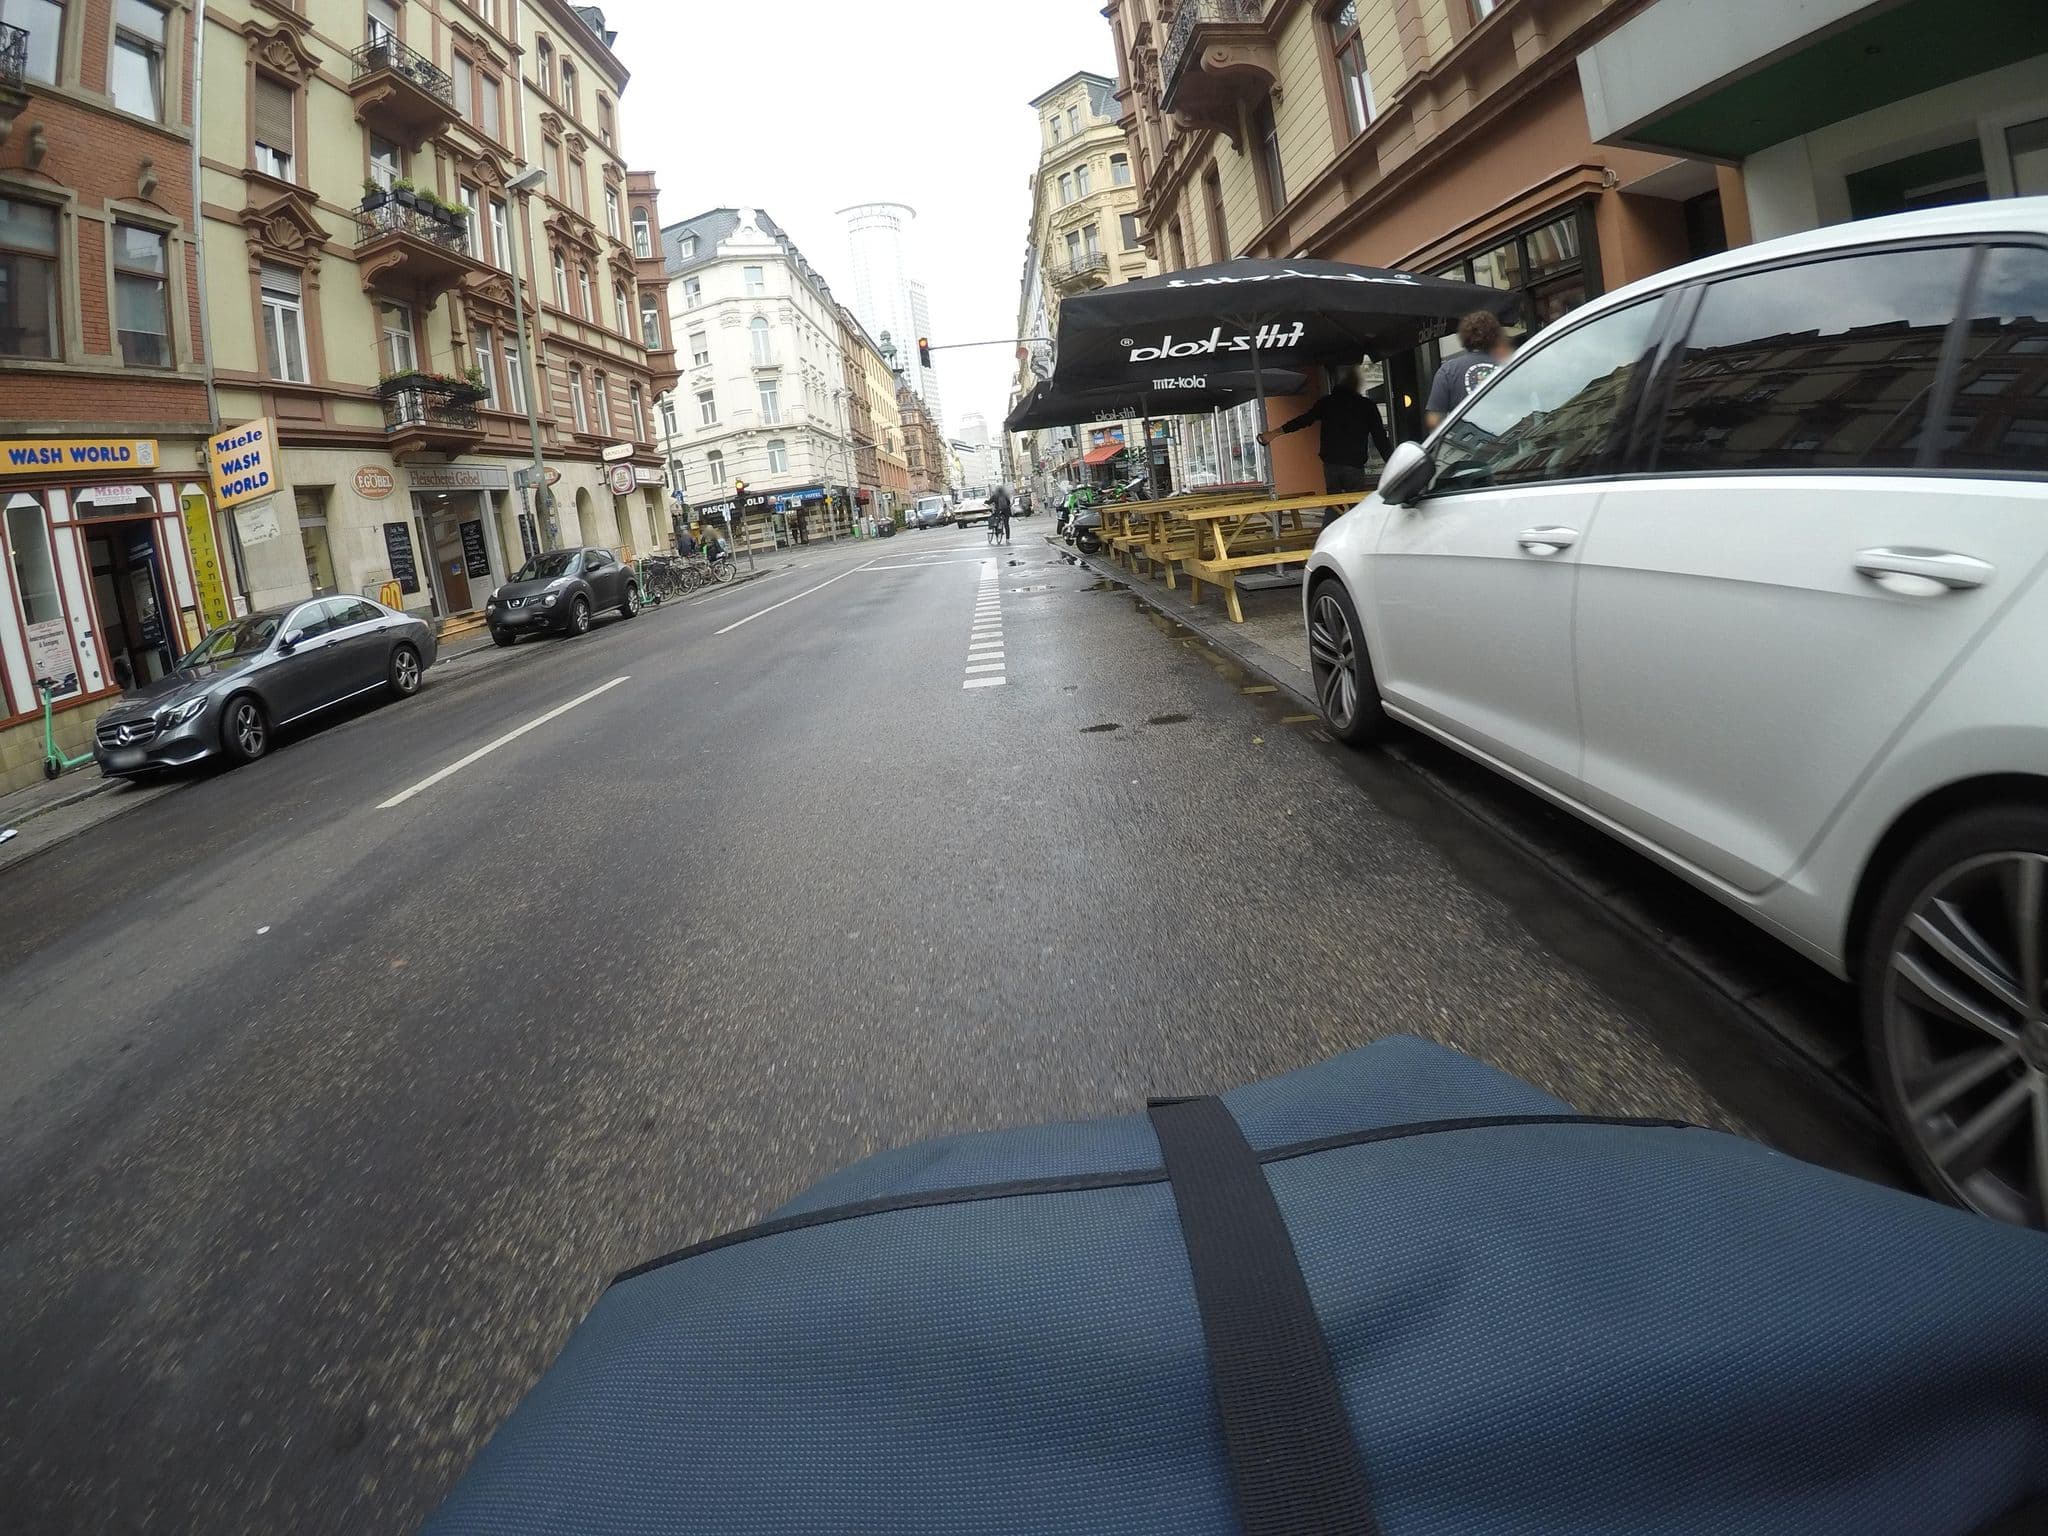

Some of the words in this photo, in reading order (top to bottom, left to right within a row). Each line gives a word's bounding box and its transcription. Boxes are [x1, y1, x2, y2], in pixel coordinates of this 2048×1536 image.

[215, 430, 263, 455] Miele
[8, 447, 63, 466] WASH
[69, 446, 131, 463] WORLD
[221, 451, 260, 477] WASH
[220, 471, 269, 499] WORLD
[409, 469, 455, 486] Fleischerei
[456, 470, 481, 486] Göbel
[94, 485, 133, 497] Miele
[743, 496, 765, 507] OLD
[182, 499, 210, 620] Dry-cleanin
[203, 533, 224, 620] Ironing
